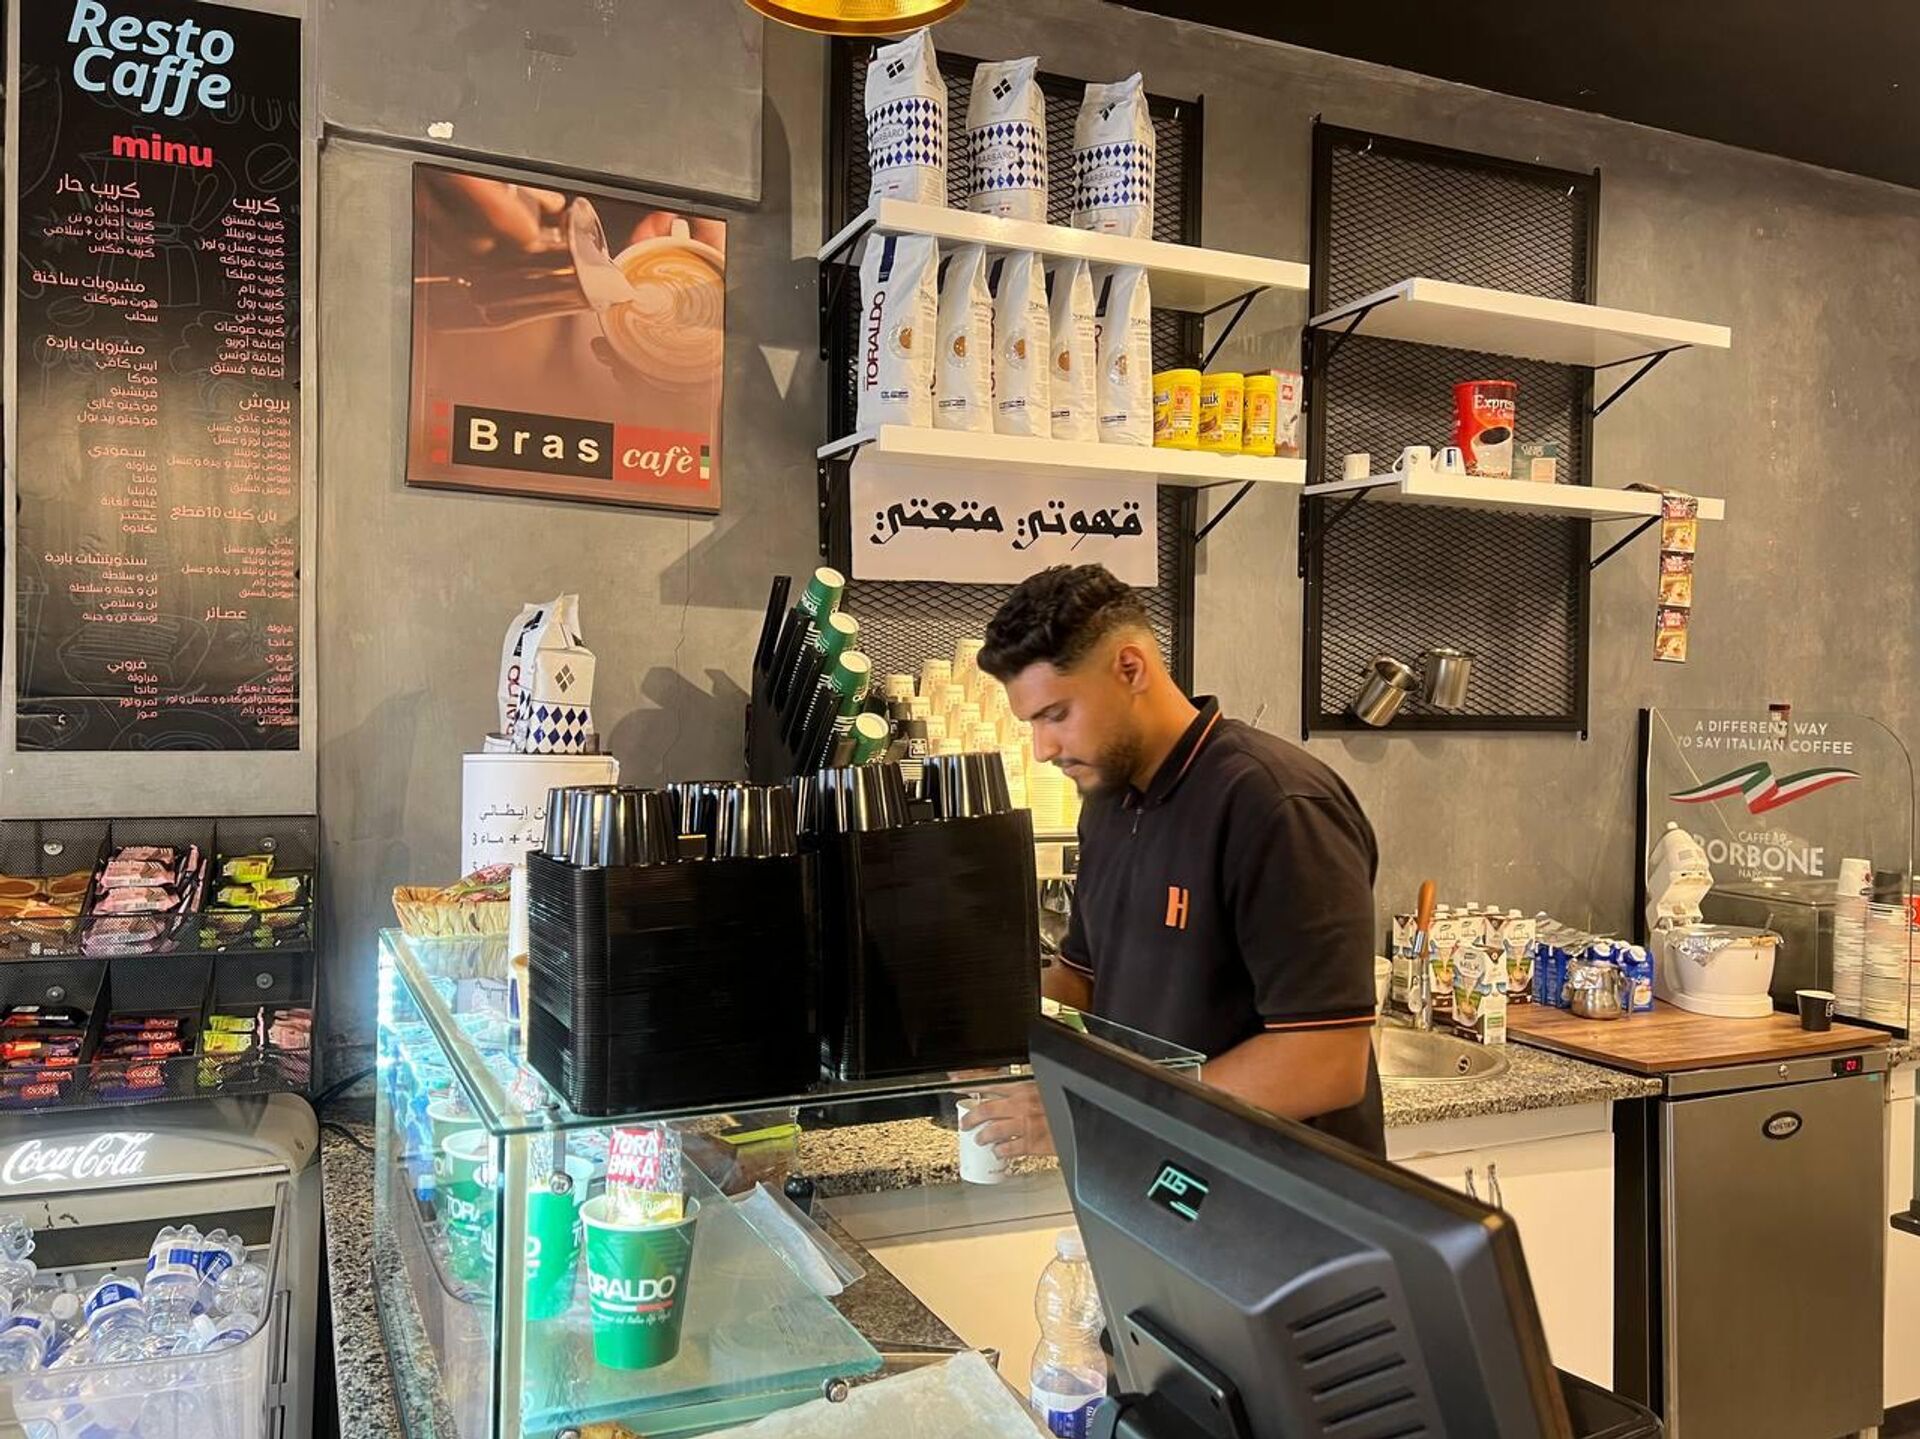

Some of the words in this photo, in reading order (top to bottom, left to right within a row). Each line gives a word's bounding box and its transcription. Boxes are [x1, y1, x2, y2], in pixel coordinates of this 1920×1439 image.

[68, 0, 234, 64] Resto
[73, 45, 231, 117] Caffe
[112, 133, 213, 168] minu
[56, 173, 84, 194] حار
[90, 181, 141, 200] كريب
[233, 197, 280, 215] كريب
[81, 275, 145, 293] مشروبات
[81, 338, 145, 355] مشروبات
[866, 291, 886, 391] TORALDO
[469, 419, 600, 463] Bras
[622, 445, 694, 476] cafè
[870, 498, 1003, 544] متعتي
[1012, 501, 1142, 550] قهوتي
[1695, 721, 1703, 732] A
[1708, 720, 1787, 734] DIFFERENT
[1794, 723, 1828, 735] WAY
[1696, 737, 1720, 749] SAY
[1726, 738, 1785, 751] ITALIAN
[1790, 740, 1853, 754] COFFEE
